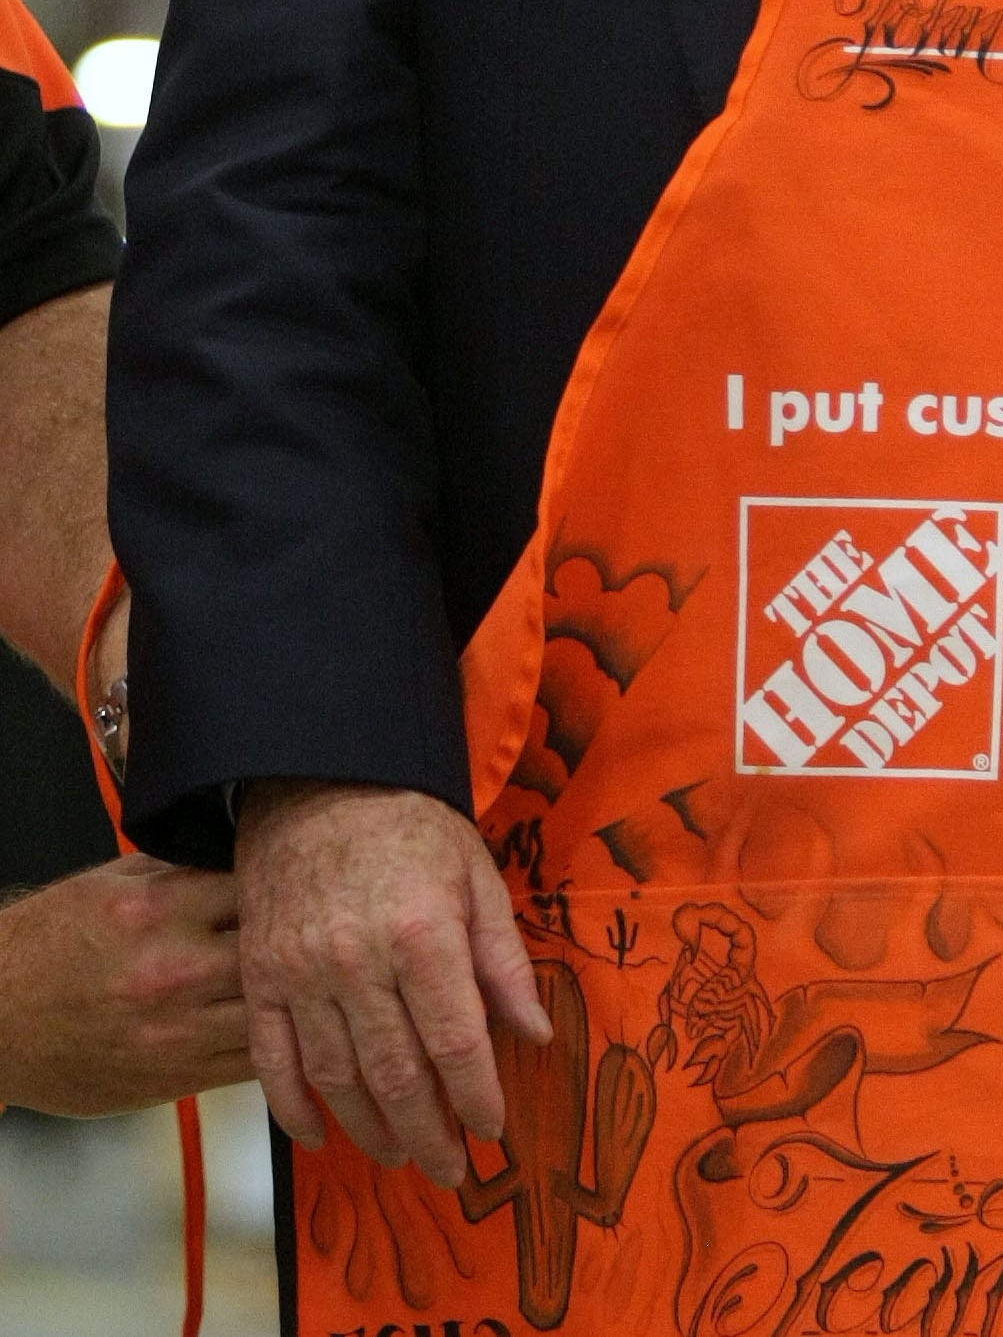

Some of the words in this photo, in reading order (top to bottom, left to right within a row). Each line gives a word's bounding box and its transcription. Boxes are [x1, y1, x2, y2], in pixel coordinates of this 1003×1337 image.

[727, 374, 743, 430] I
[769, 381, 883, 447] put
[738, 507, 1000, 769] HOME
[764, 529, 874, 639] THE
[838, 604, 1000, 770] DEPOT
